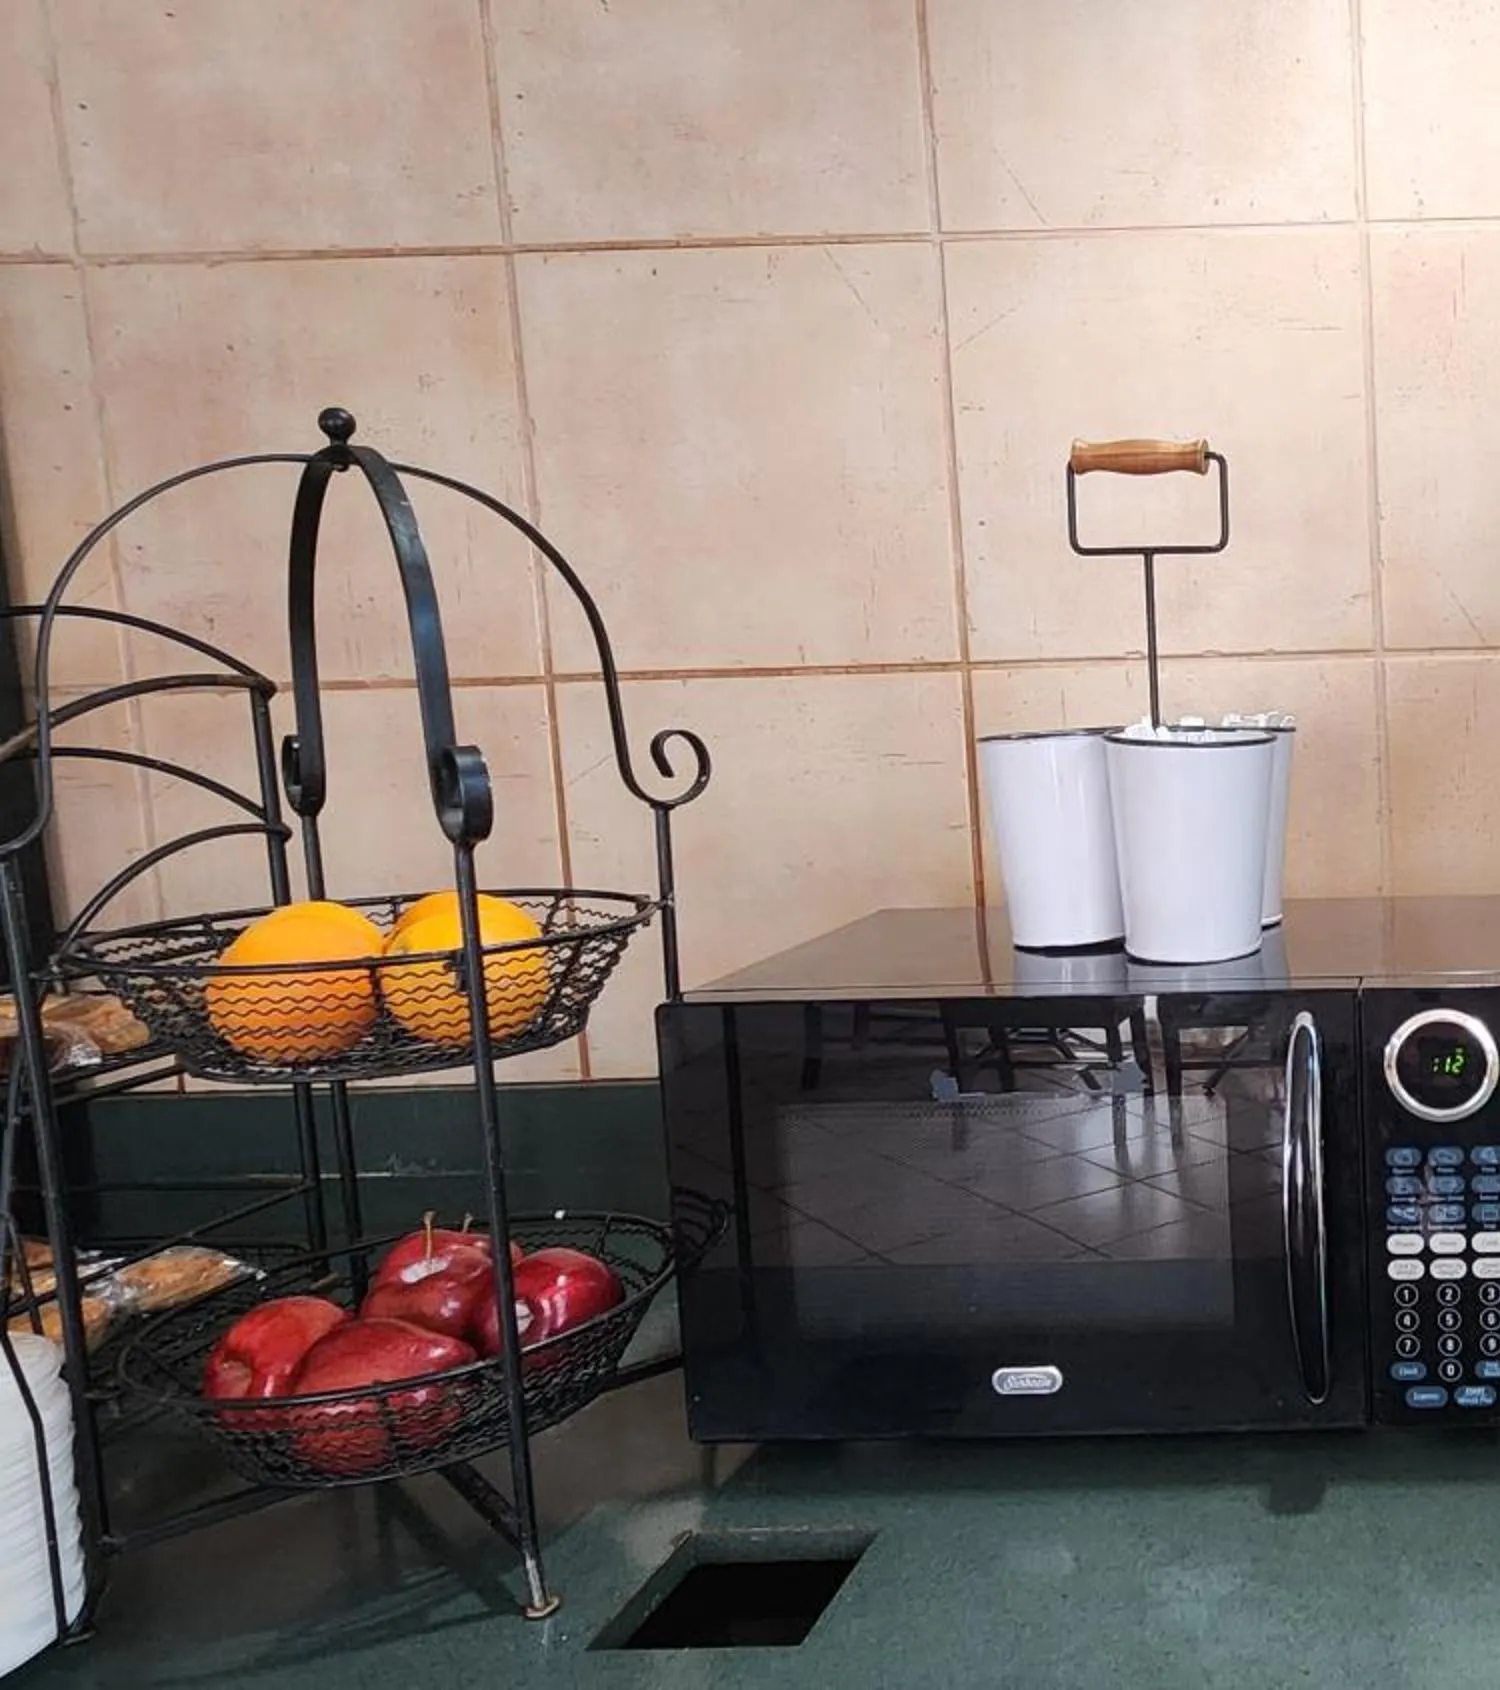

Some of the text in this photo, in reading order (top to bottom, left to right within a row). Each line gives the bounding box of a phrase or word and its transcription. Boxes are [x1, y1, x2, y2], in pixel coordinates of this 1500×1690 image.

[1403, 1287, 1496, 1302] 1 2 3
[1403, 1313, 1411, 1327] 4
[1445, 1313, 1454, 1326] 5
[1403, 1339, 1412, 1352] 7
[1446, 1363, 1455, 1376] 0
